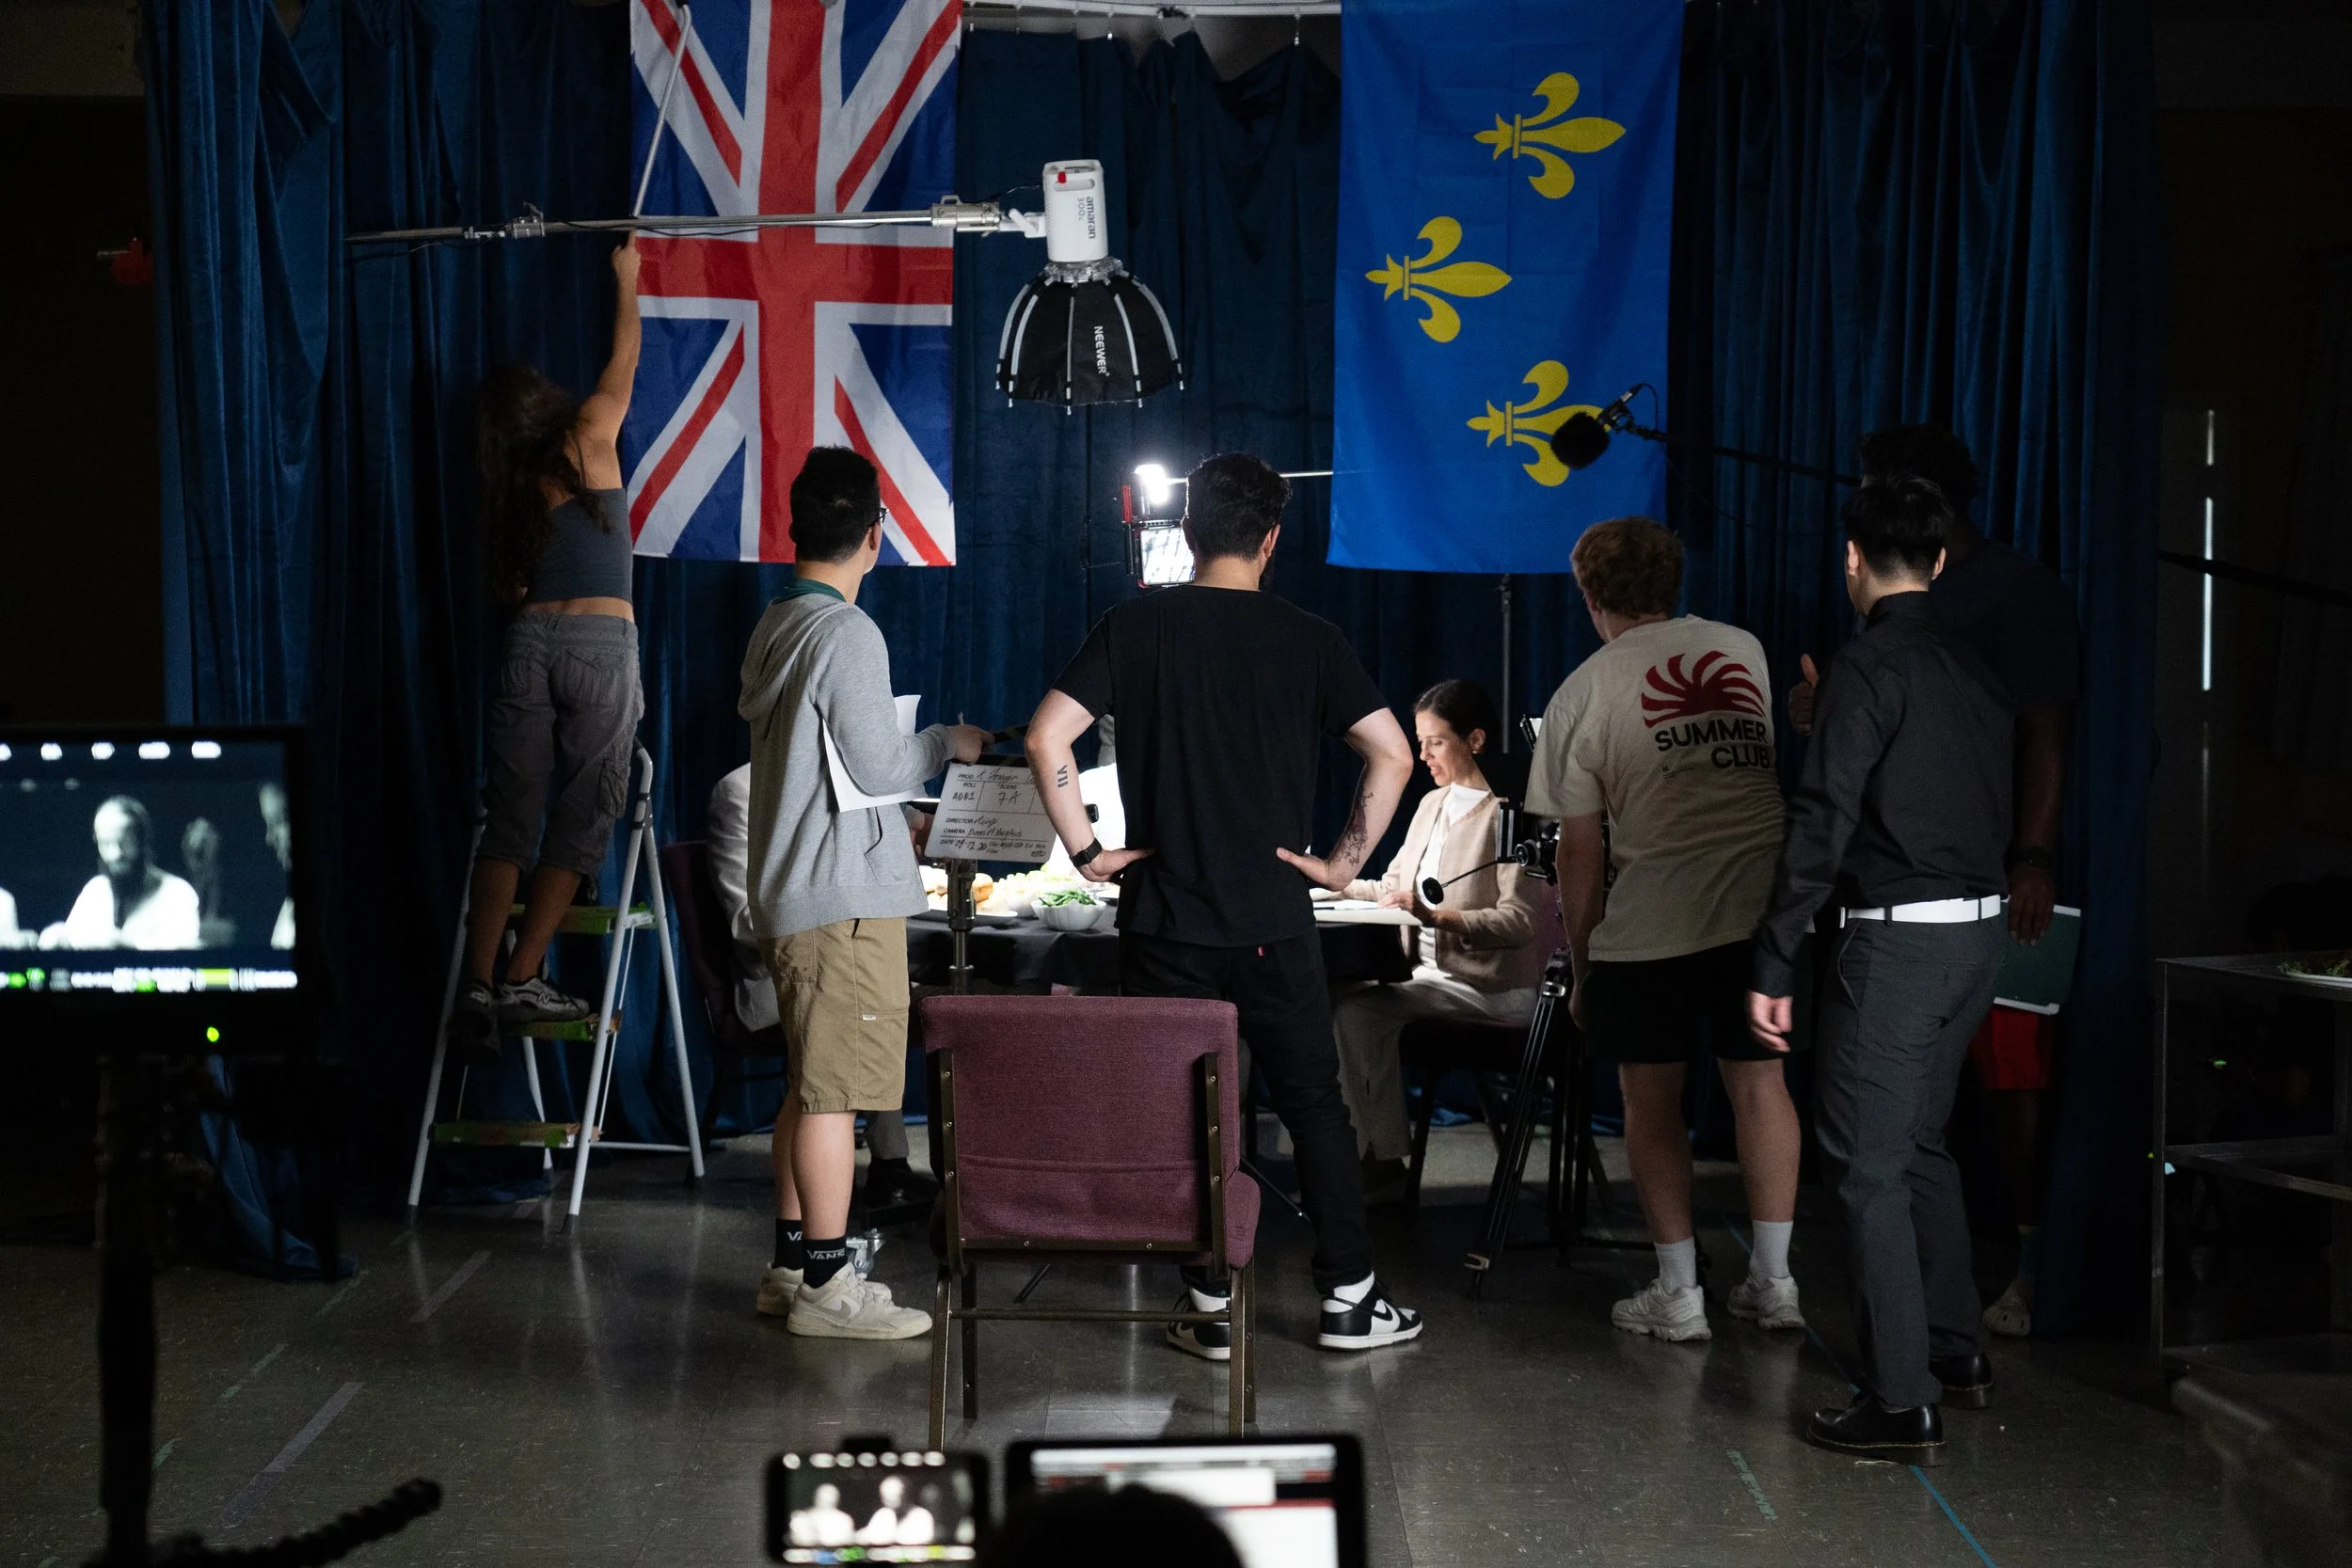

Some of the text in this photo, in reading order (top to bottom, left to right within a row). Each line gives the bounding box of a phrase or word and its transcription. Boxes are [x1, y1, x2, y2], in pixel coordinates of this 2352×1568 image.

[1086, 196, 1096, 239] amaran
[1655, 720, 1767, 752] SUMMER
[1710, 744, 1772, 769] CLUB
[807, 1248, 845, 1259] VANS
